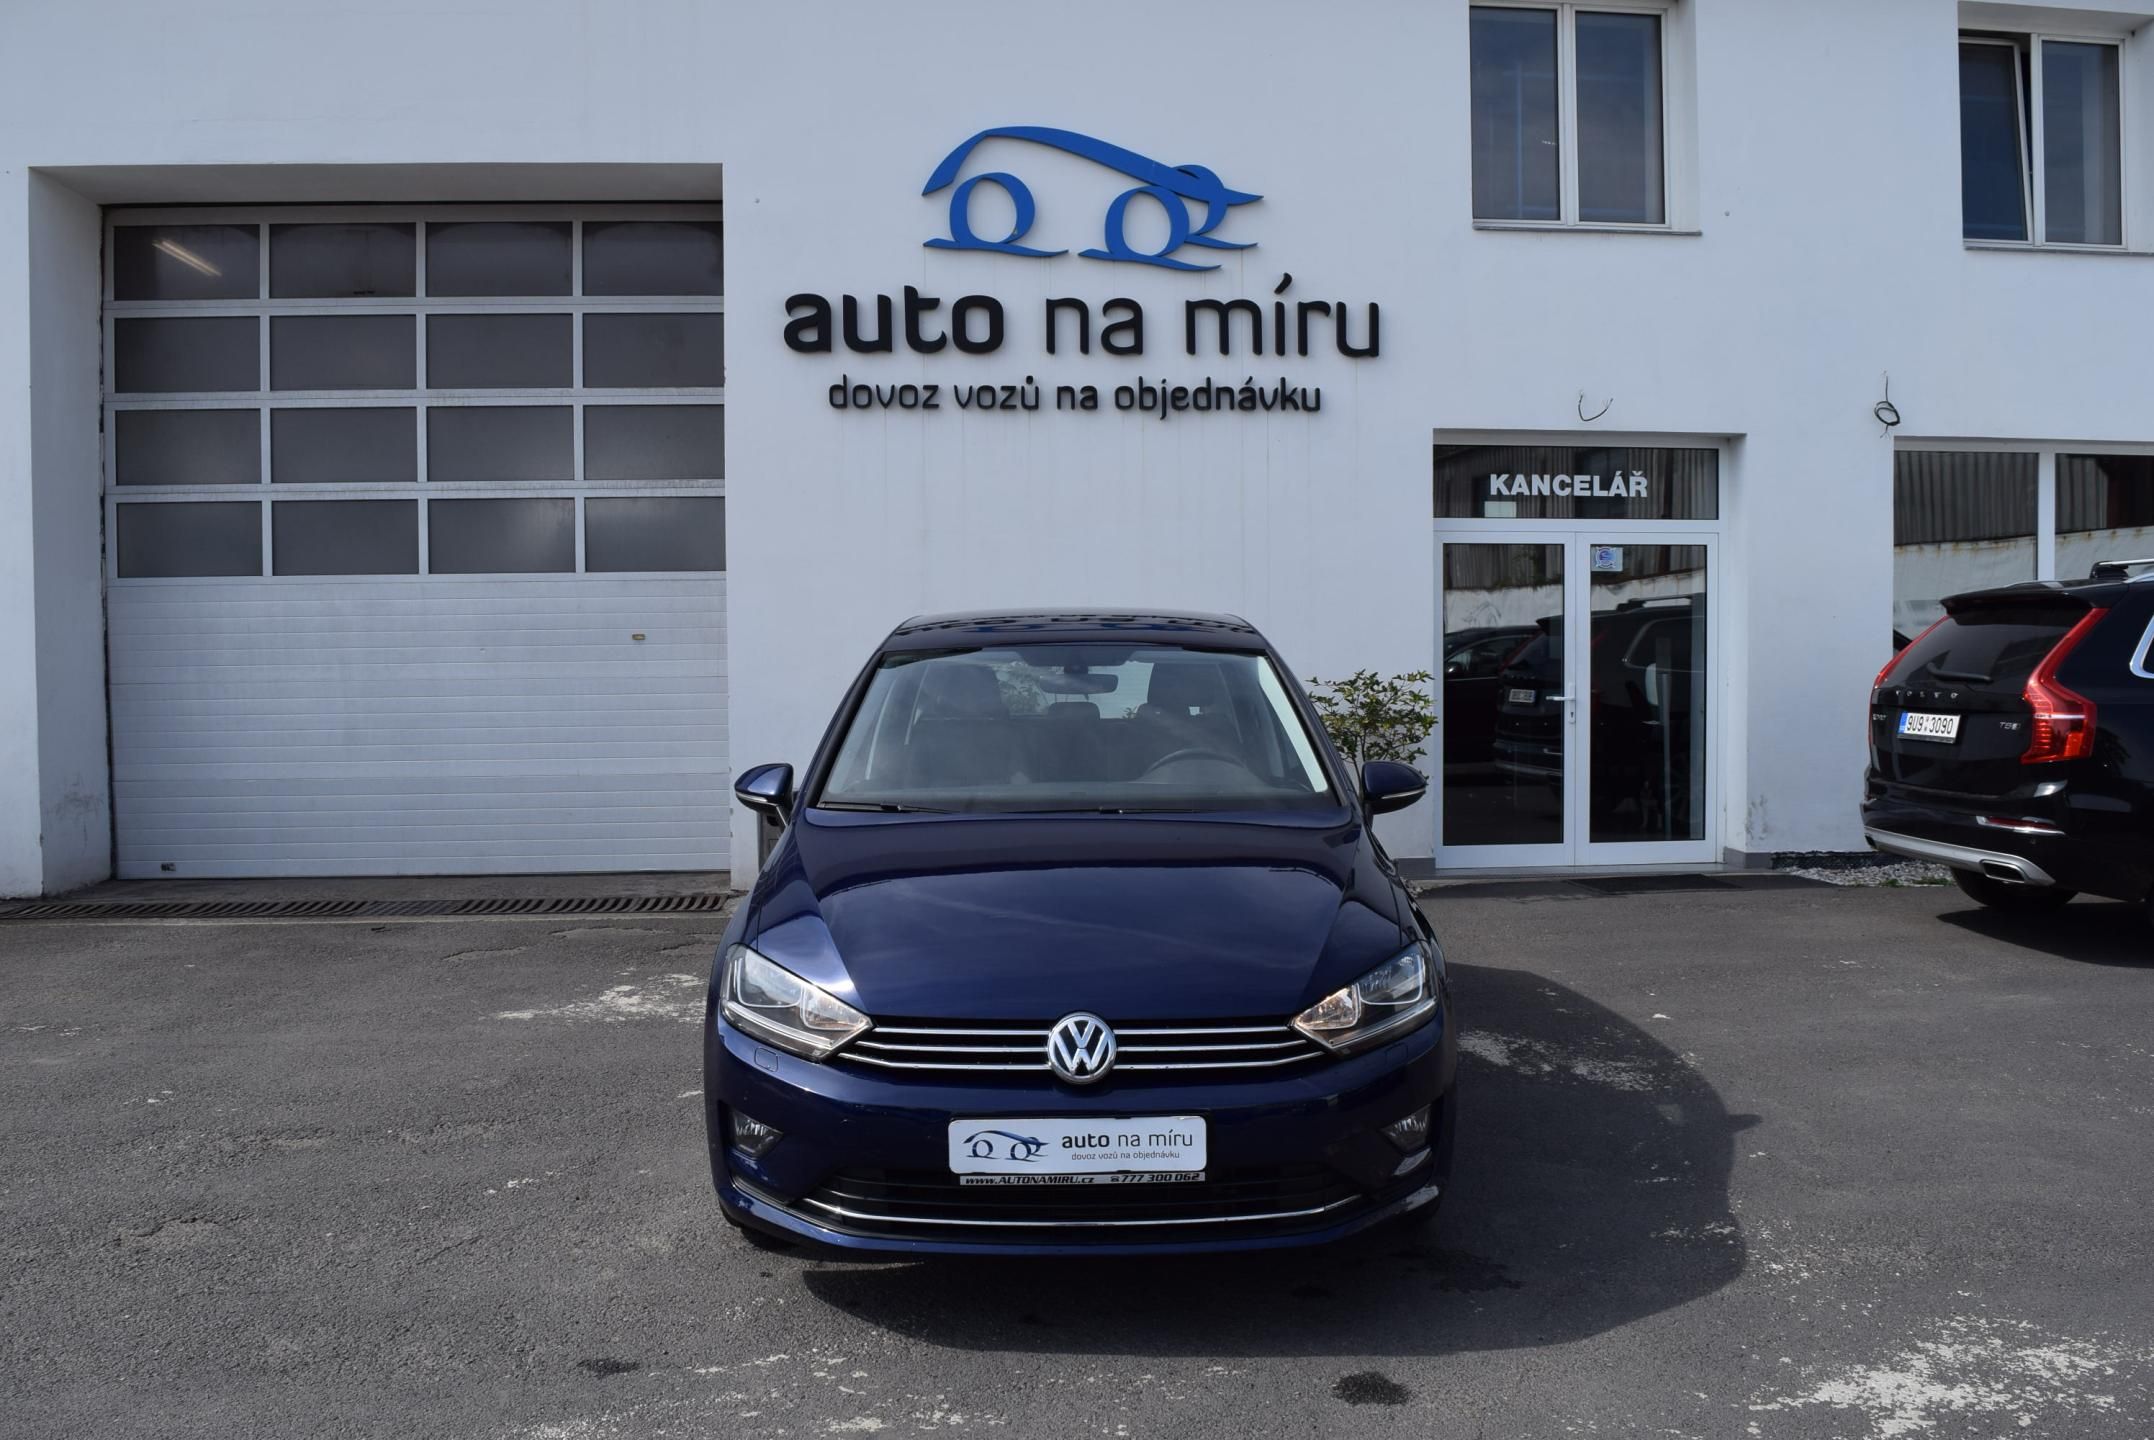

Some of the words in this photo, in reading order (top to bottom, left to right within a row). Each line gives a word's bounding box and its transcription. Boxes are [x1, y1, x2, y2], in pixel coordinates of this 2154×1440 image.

[783, 285, 1004, 355] auto
[1045, 297, 1144, 356] na
[1185, 272, 1379, 357] míru
[828, 374, 939, 411] dovoz
[953, 375, 1040, 411] vozů
[1056, 384, 1098, 411] na
[1114, 376, 1321, 420] objednávku
[1489, 470, 1648, 498] KANCELÁŘ
[1907, 714, 1924, 732] 9U9
[1929, 715, 1954, 735] 3090
[1061, 1133, 1110, 1149] auto
[1118, 1134, 1140, 1147] na
[1148, 1129, 1193, 1147] míru
[1071, 1152, 1096, 1161] dovoz
[1098, 1151, 1118, 1160] vozů
[1133, 1150, 1180, 1161] objednávku
[1119, 1174, 1144, 1183] 777
[1148, 1173, 1172, 1182] 300
[1174, 1172, 1200, 1181] 062
